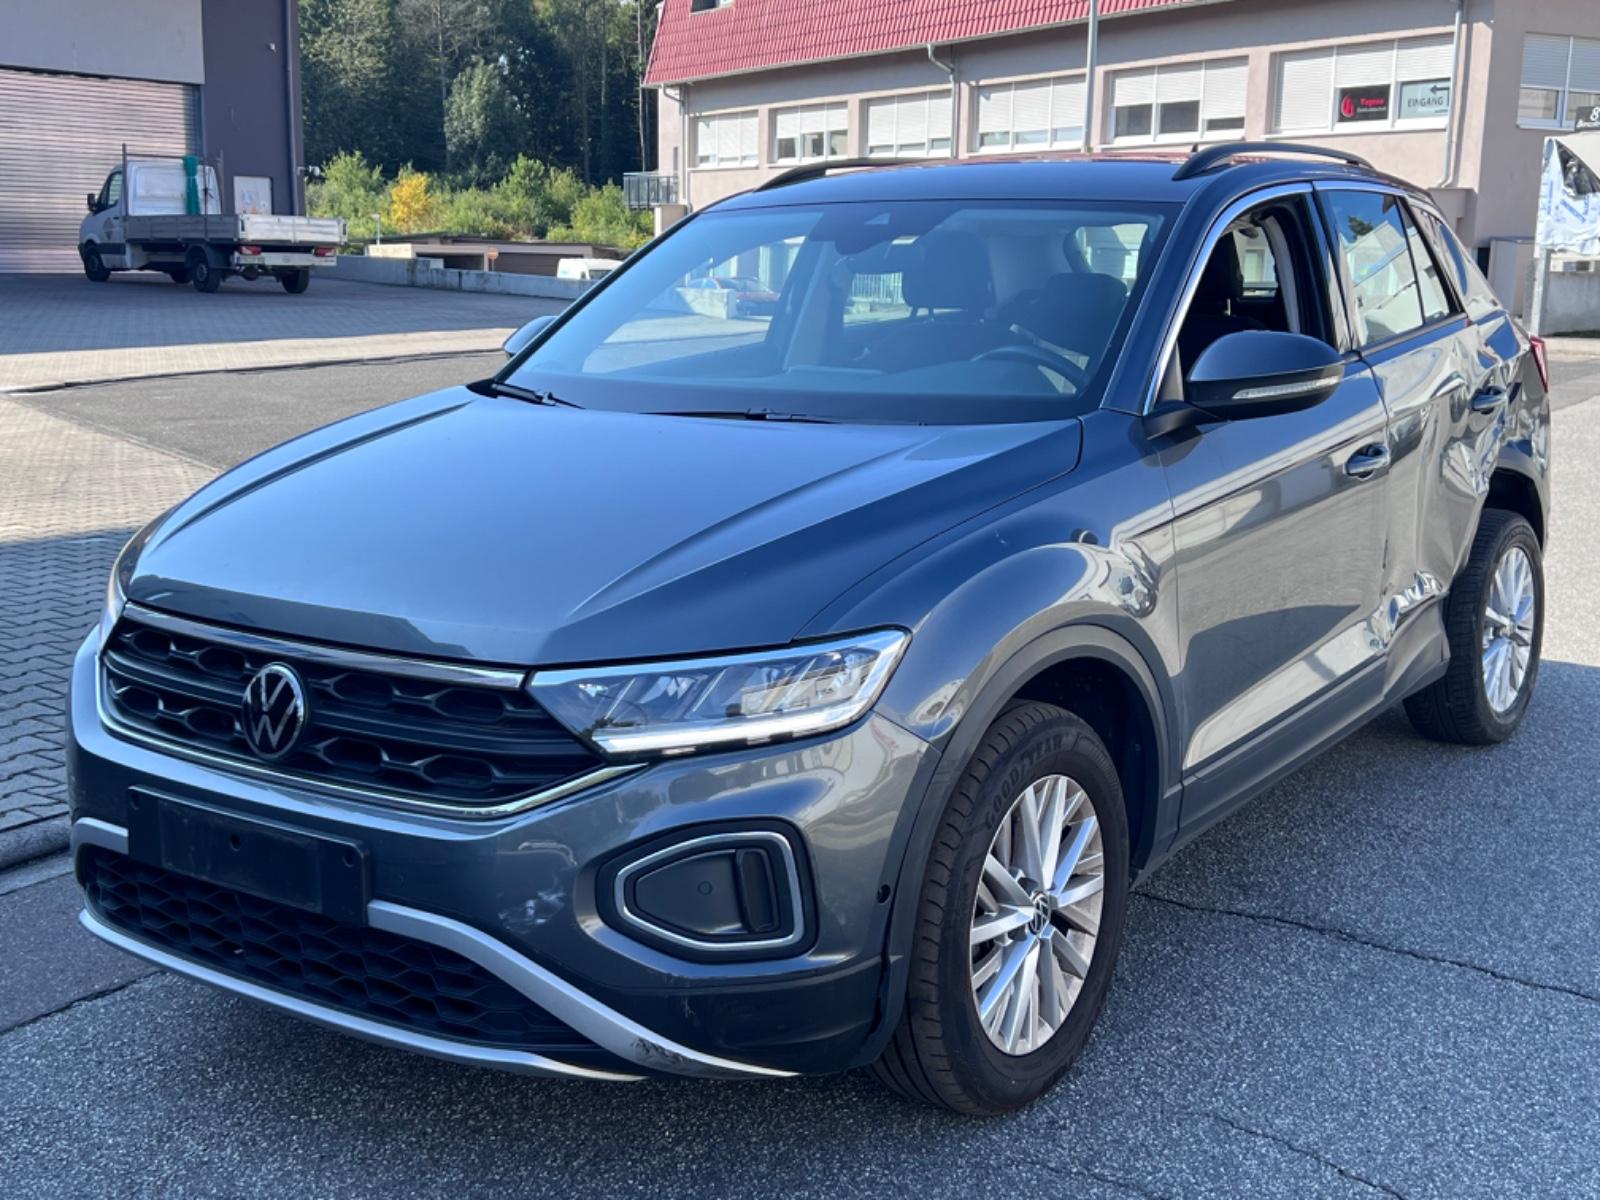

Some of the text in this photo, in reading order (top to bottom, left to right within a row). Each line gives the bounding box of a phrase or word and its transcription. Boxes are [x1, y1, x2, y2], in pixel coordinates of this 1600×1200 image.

[1407, 96, 1444, 107] EINGANG
[1590, 106, 1600, 121] 8
[244, 667, 302, 753] VW
[985, 733, 1064, 830] GOODYEAR
